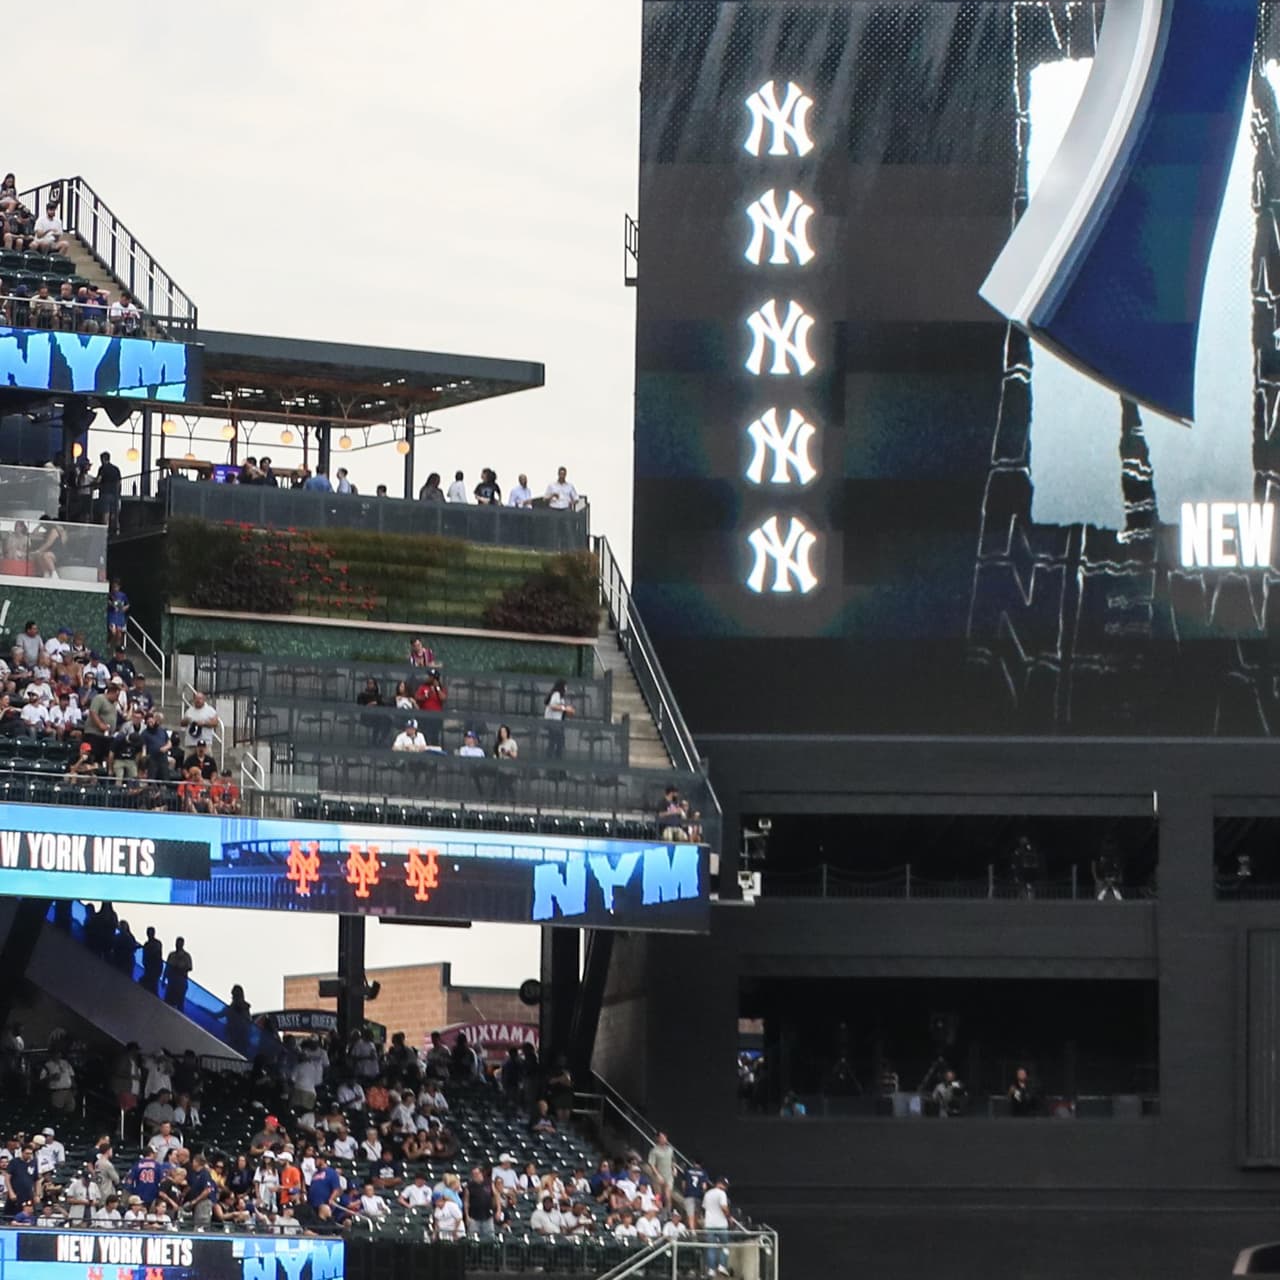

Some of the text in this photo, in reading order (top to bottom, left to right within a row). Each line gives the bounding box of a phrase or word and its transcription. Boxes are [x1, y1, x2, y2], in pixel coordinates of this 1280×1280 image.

[1180, 502, 1274, 568] NEW
[28, 832, 87, 872] YORK
[93, 836, 156, 876] METS
[532, 844, 700, 921] NYM
[57, 1234, 193, 1267] NEW YORK METS
